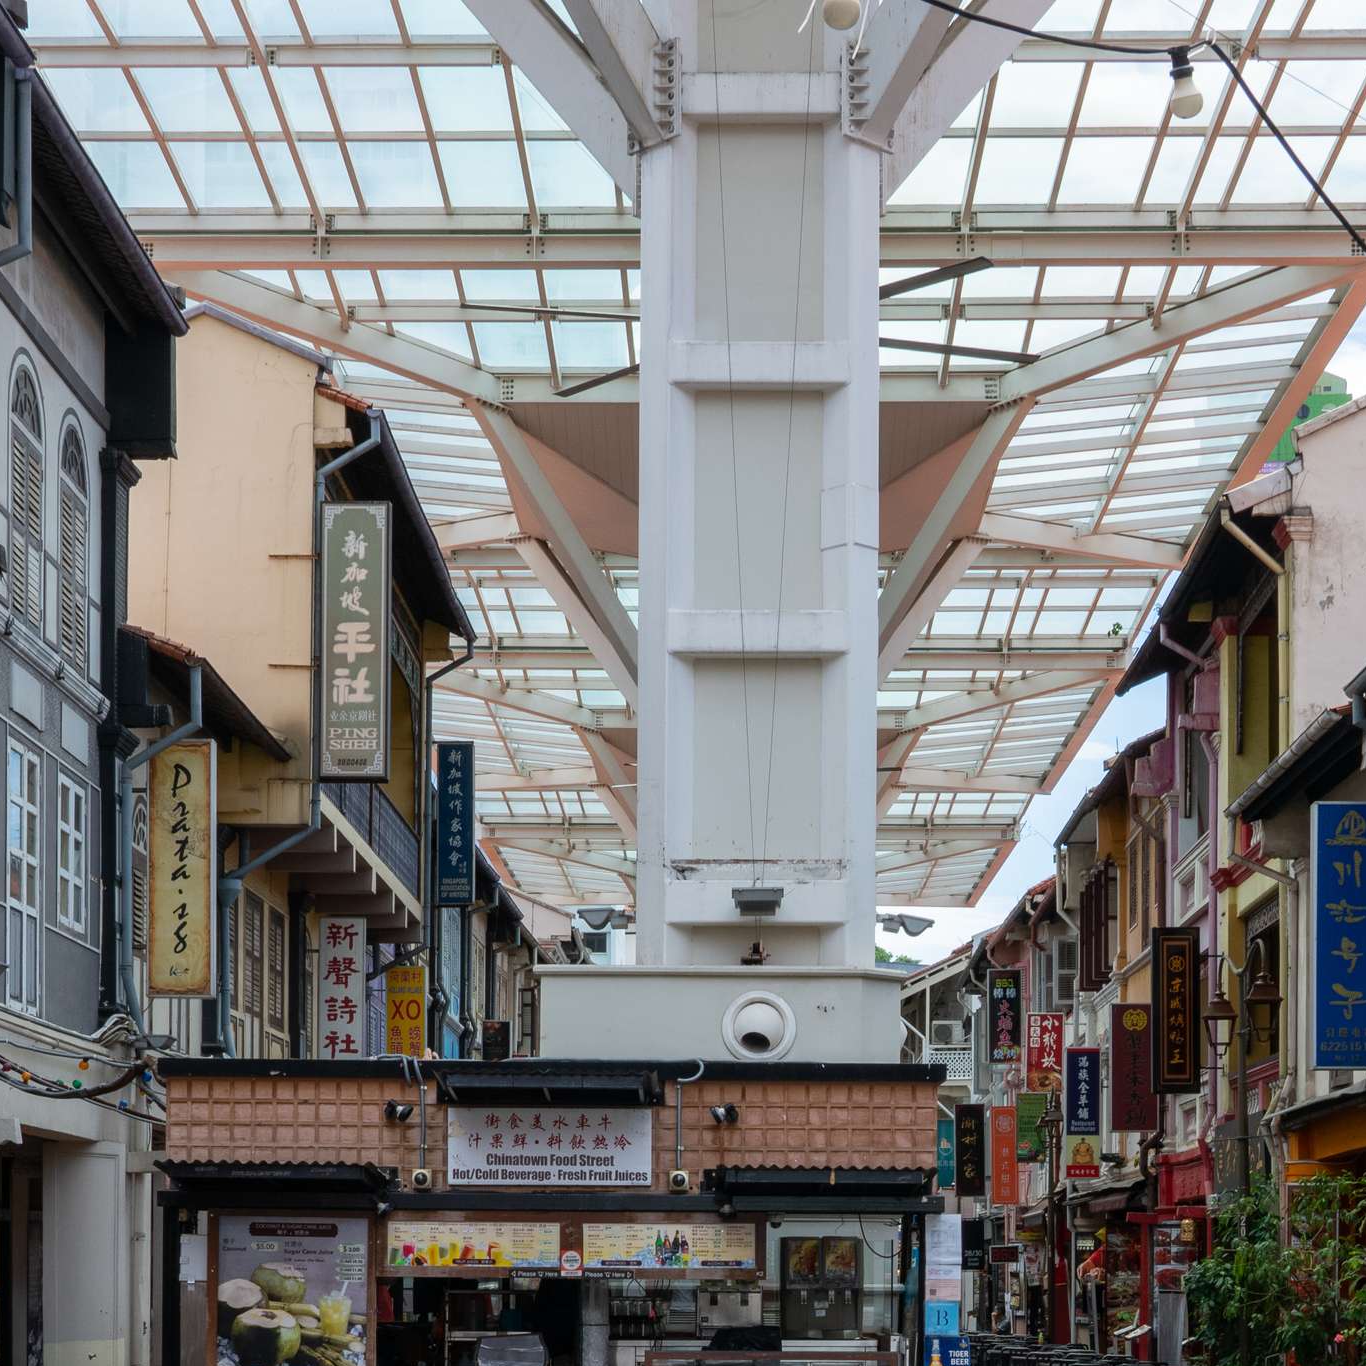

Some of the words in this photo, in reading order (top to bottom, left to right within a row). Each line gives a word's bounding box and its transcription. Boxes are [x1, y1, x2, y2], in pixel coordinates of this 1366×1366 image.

[328, 727, 378, 738] PING
[323, 923, 360, 1059] 新聲詩社
[391, 999, 421, 1020] XO
[486, 1153, 548, 1167] Chinatown
[549, 1153, 577, 1167] Food
[579, 1154, 615, 1167] Street
[452, 1168, 499, 1180] Hot/Cold
[501, 1168, 551, 1182] Beverage
[558, 1169, 586, 1180] Fresh
[588, 1169, 613, 1181] Fruit
[614, 1169, 648, 1182] Juices
[950, 1358, 969, 1366] BEER
